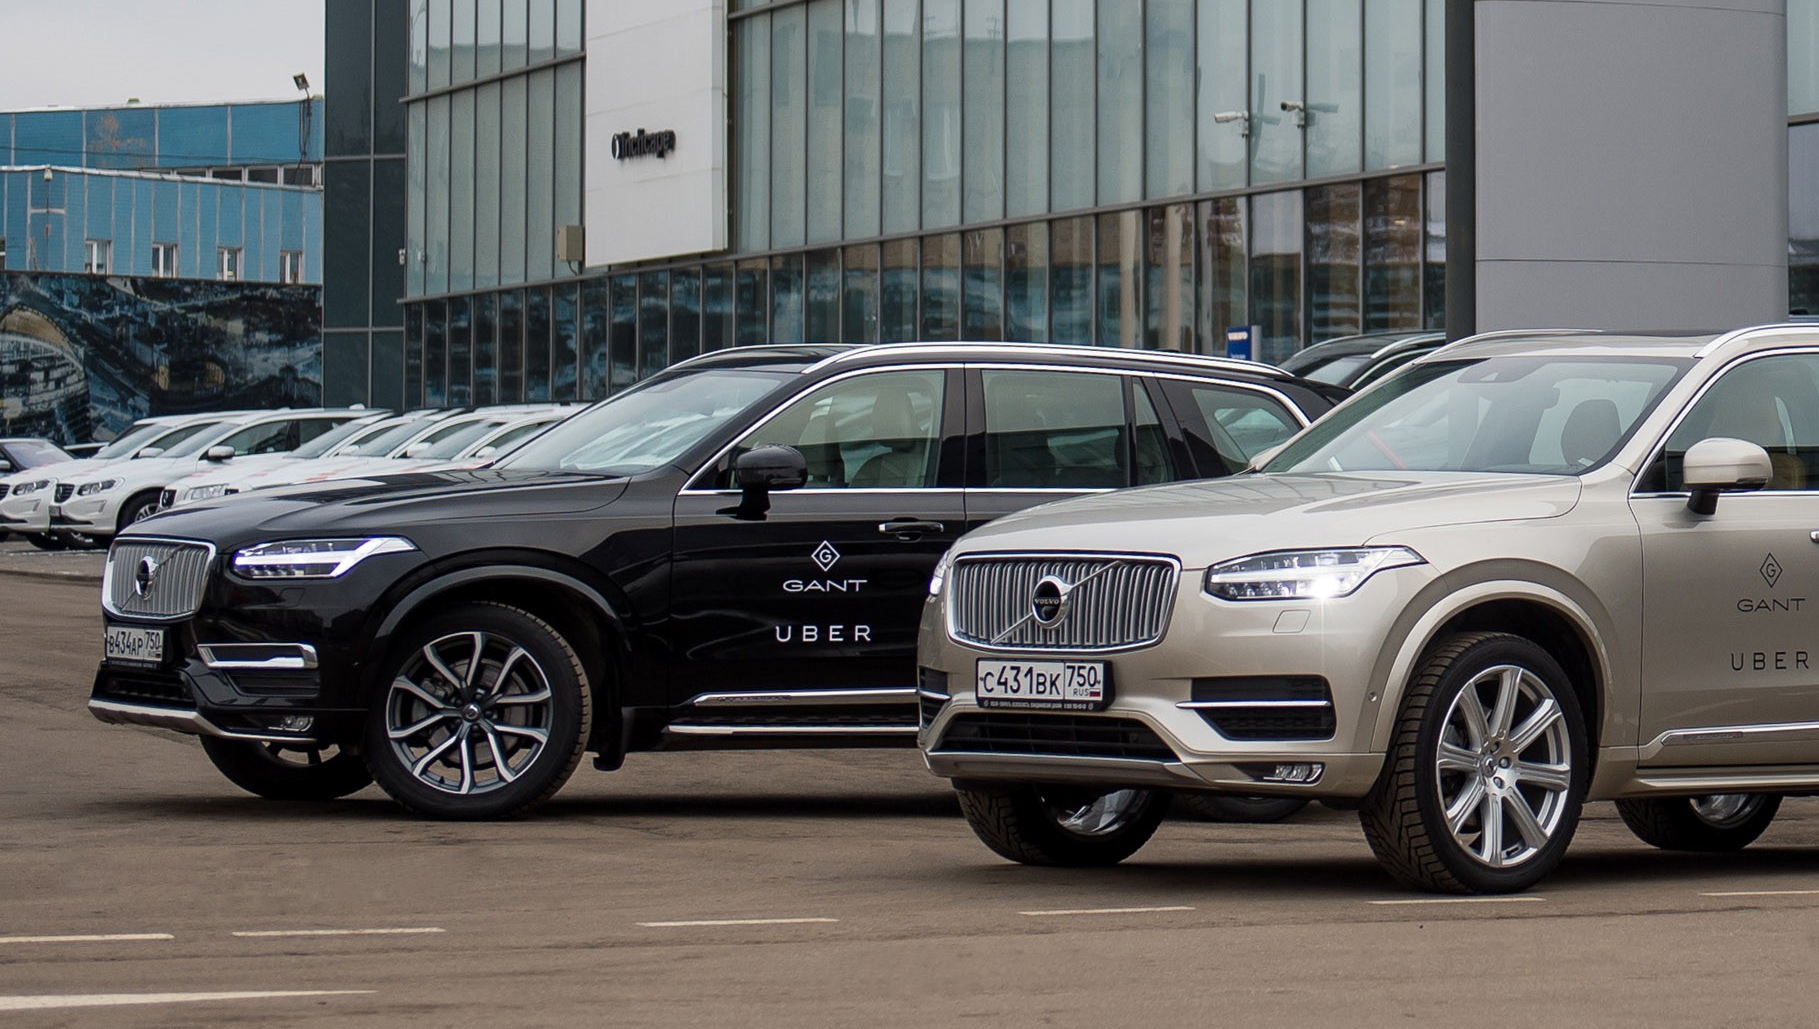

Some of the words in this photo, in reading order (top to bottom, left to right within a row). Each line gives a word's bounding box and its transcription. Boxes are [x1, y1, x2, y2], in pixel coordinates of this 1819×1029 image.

[620, 128, 676, 159] Inchcape
[783, 579, 868, 592] GANT
[1736, 598, 1806, 613] GANT
[145, 631, 161, 650] 750
[775, 625, 871, 642] UBER
[1730, 651, 1810, 671] UBER
[1066, 665, 1098, 688] 750
[1073, 688, 1089, 697] RUS
